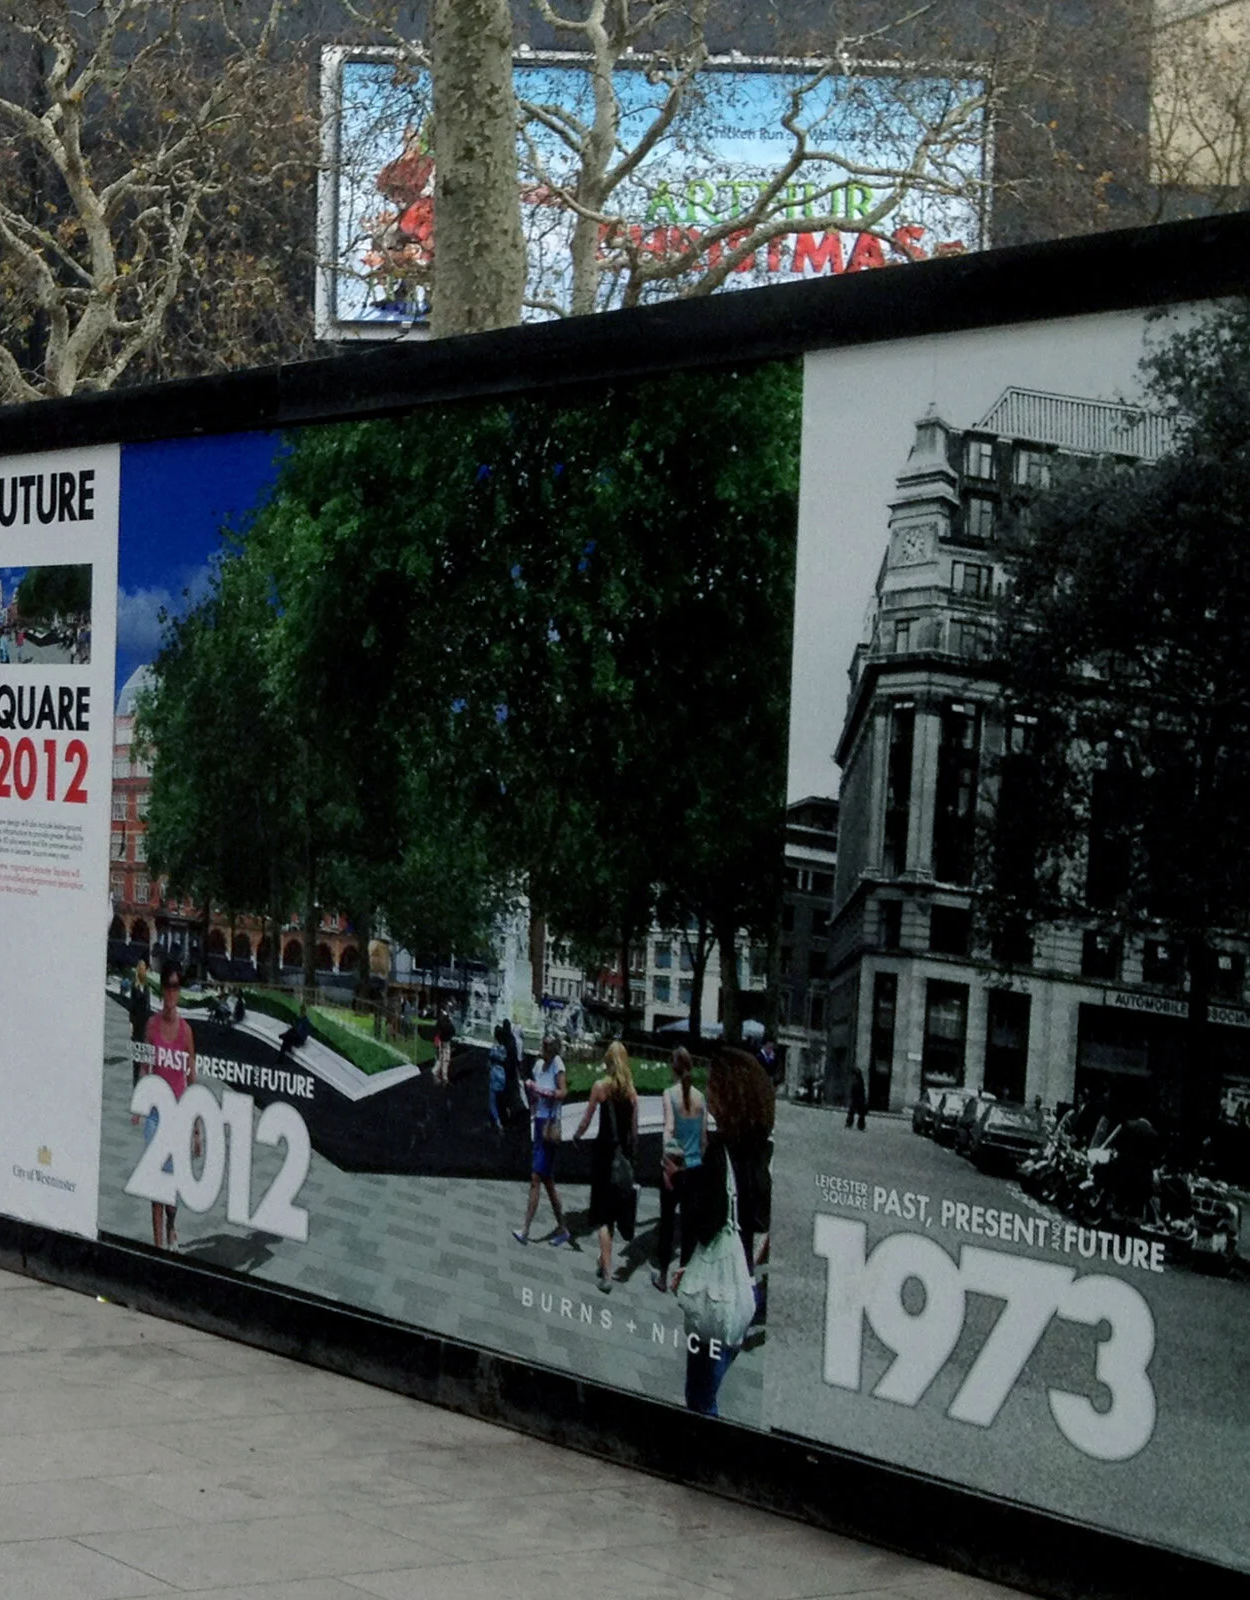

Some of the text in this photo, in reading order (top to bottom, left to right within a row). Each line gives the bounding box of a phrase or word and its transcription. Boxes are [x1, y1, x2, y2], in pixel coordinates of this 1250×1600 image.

[759, 127, 784, 141] Run
[647, 180, 880, 224] ARTHUR
[1115, 994, 1189, 1017] AUTOMOBILE
[157, 1046, 191, 1076] PAST,
[195, 1053, 253, 1086] PRESENT
[260, 1070, 315, 1099] FUTURE
[12, 1164, 77, 1192] City of Westminster
[124, 1074, 312, 1243] 2012
[814, 1174, 869, 1197] LEICESTER
[822, 1189, 869, 1211] SQUARE
[873, 1185, 1166, 1274] PAST, PRESENT AND FUTURE
[521, 1287, 613, 1330] BURNS
[651, 1323, 723, 1361] NICE
[812, 1213, 1157, 1462] 1973
